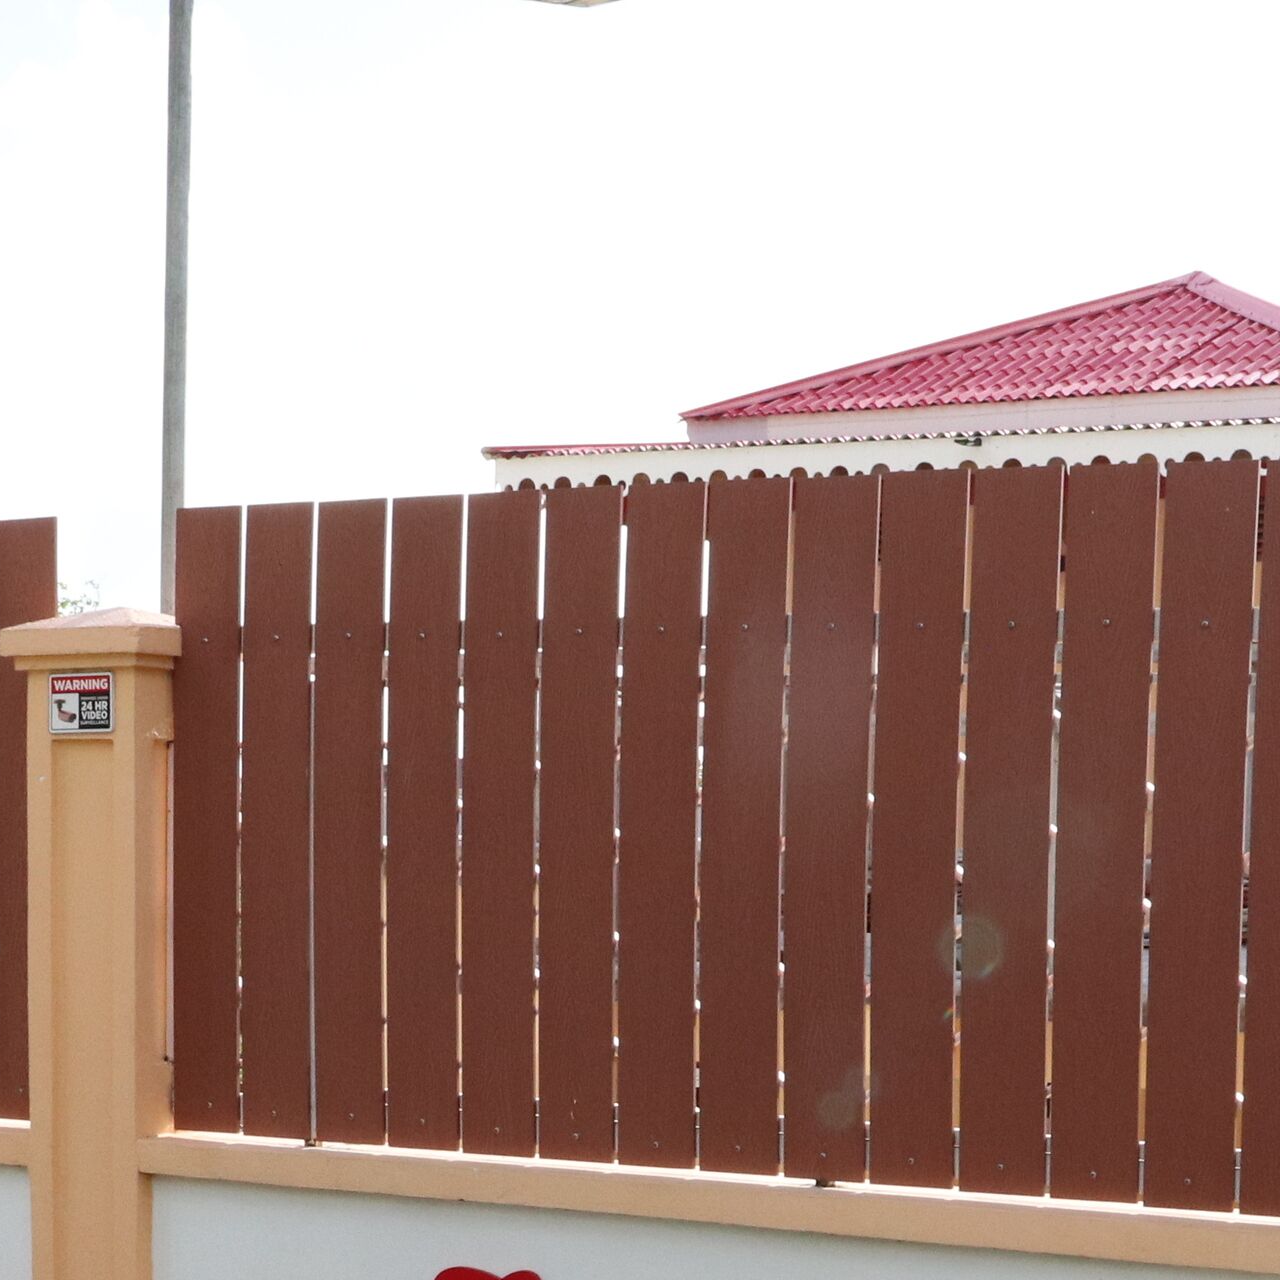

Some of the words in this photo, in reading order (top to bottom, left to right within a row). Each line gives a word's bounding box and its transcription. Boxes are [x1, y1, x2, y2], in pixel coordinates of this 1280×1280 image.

[53, 679, 108, 691] WARNING
[81, 701, 93, 711] 24
[95, 700, 108, 711] HR
[81, 711, 108, 720] VIDEO
